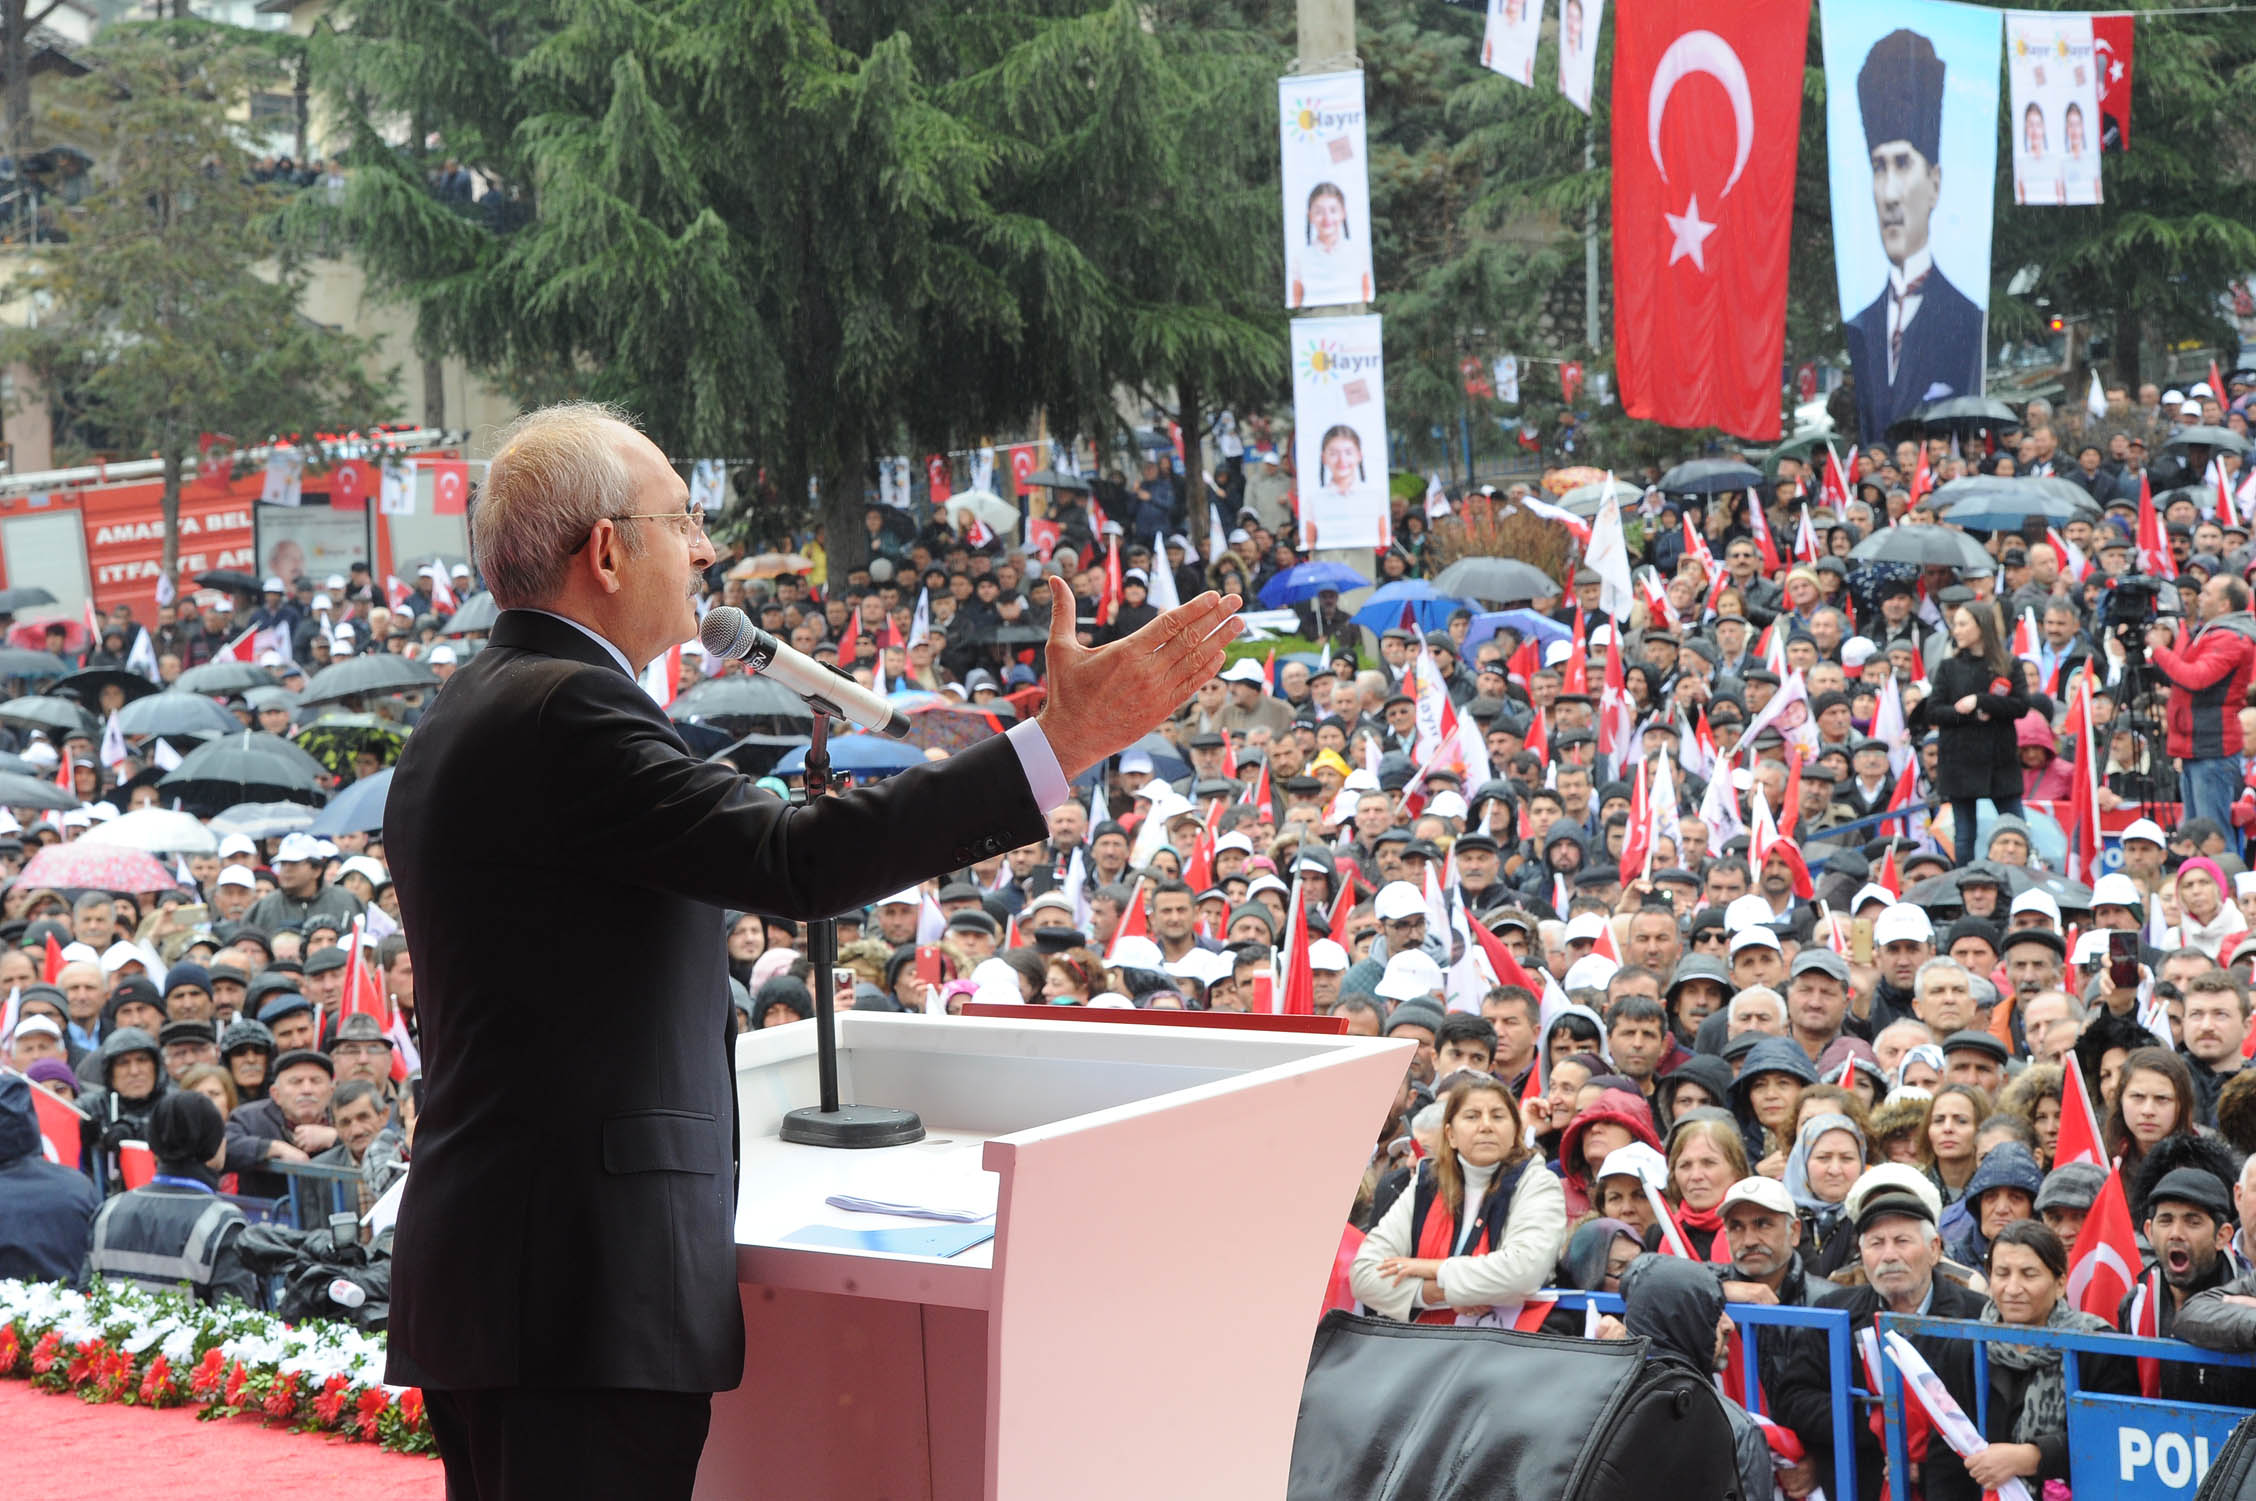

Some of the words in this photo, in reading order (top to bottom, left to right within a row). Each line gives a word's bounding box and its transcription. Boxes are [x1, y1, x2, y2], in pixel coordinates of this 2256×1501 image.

[1308, 112, 1361, 131] Hayır
[1322, 352, 1380, 373] Hayır
[95, 517, 201, 545] AMASA
